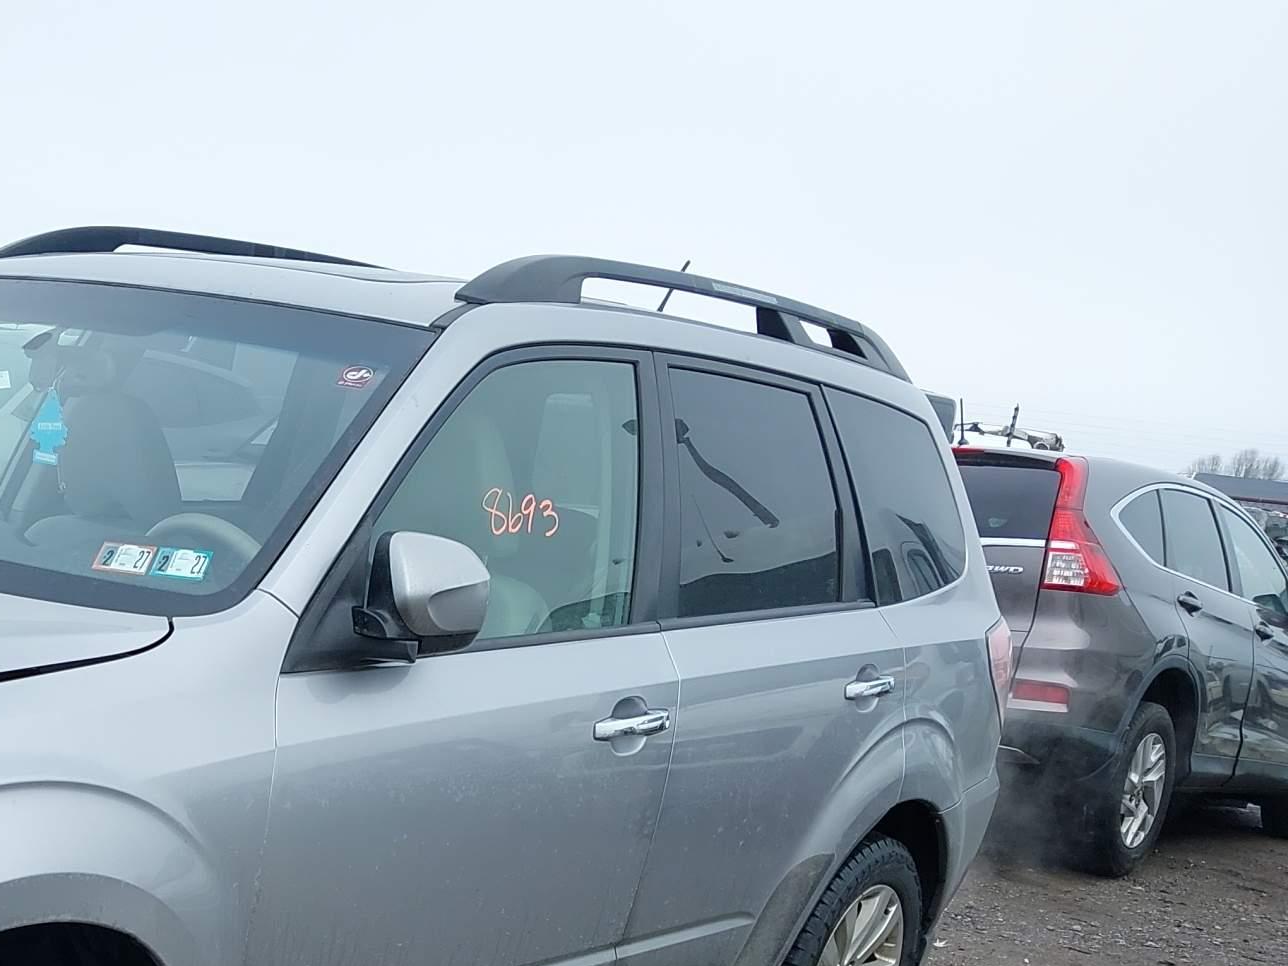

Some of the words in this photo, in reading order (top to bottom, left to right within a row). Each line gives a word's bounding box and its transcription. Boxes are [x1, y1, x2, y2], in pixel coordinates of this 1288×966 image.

[481, 487, 559, 537] 8693
[102, 549, 115, 566] 2
[133, 550, 151, 570] 27
[157, 554, 170, 572] 2
[190, 555, 208, 575] 27
